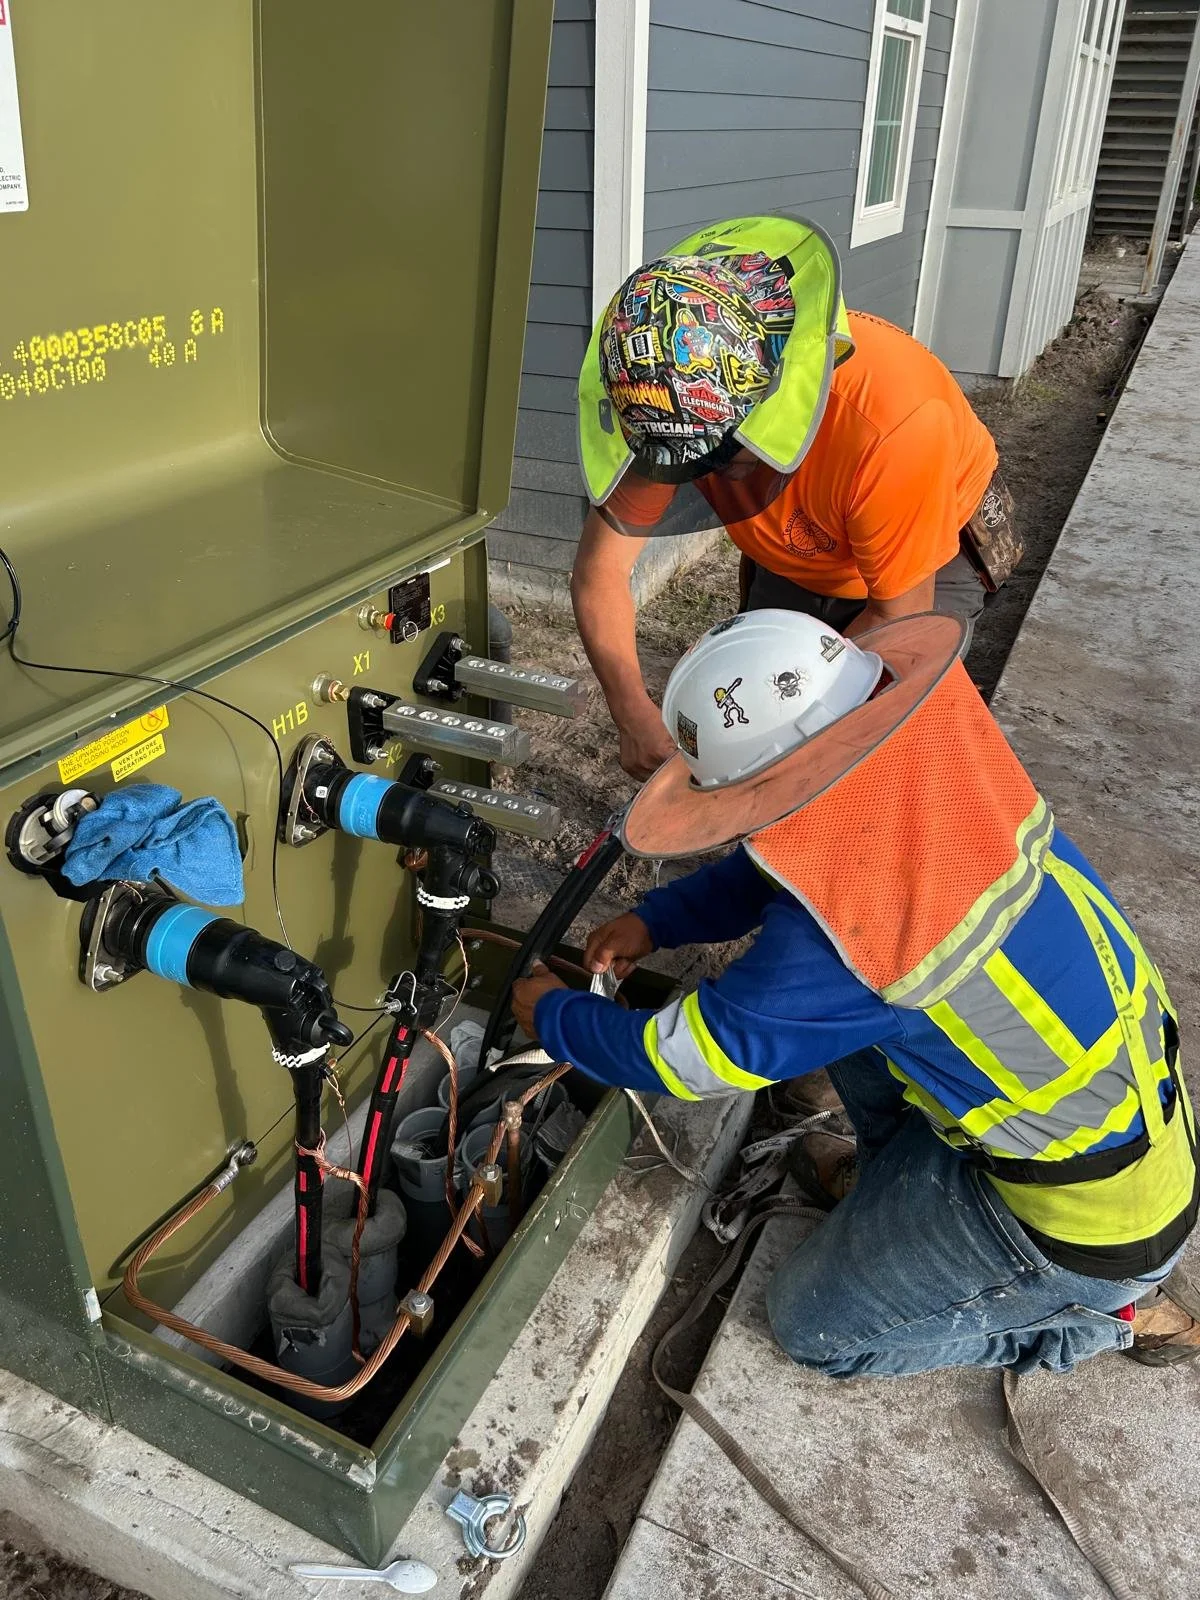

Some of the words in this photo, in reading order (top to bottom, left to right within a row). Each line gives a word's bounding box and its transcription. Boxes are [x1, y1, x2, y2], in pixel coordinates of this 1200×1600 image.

[211, 307, 224, 335] A
[185, 338, 197, 363] A
[682, 396, 731, 415] ELECTRICIAN
[430, 604, 446, 626] X3
[353, 650, 371, 676] X1
[272, 701, 309, 740] H1B
[63, 763, 83, 776] WHEN
[84, 747, 110, 766] CLOSING
[111, 736, 129, 752] HOOD
[115, 754, 148, 776] OPERATING
[148, 743, 163, 757] FUSE
[118, 753, 134, 765] VENT
[134, 739, 157, 757] BEFORE
[385, 743, 403, 768] X2
